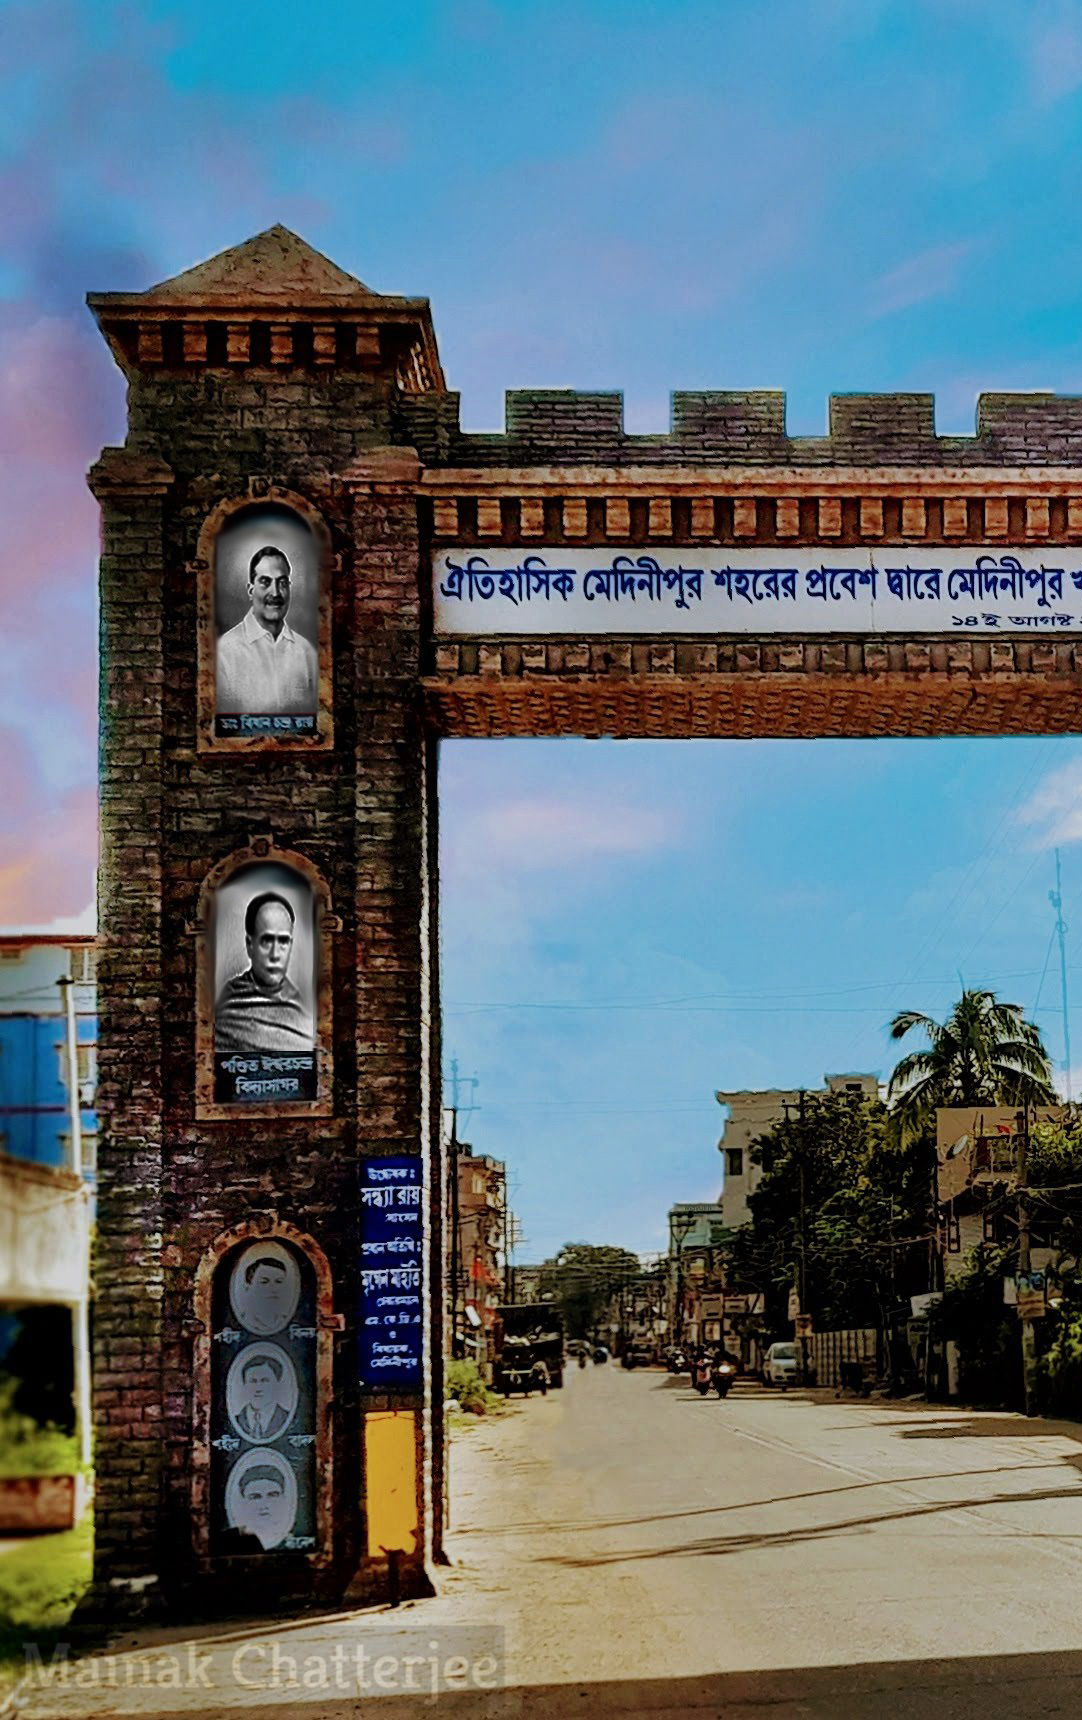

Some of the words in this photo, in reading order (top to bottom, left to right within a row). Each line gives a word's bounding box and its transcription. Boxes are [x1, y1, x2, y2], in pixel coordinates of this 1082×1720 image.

[440, 556, 576, 606] ঐতিহাসিক
[583, 556, 703, 609] মেদিনীপুর
[711, 564, 798, 605] শহরের
[806, 564, 879, 601] প্রবেশ
[885, 564, 943, 601] দ্বারে
[948, 555, 1065, 608] মেদিনীপুর
[235, 1076, 299, 1095] বিদ্যাসাগর
[360, 1185, 393, 1208] সন্ধ্যা
[396, 1185, 421, 1205] রায়
[390, 1259, 421, 1290] মাইতি
